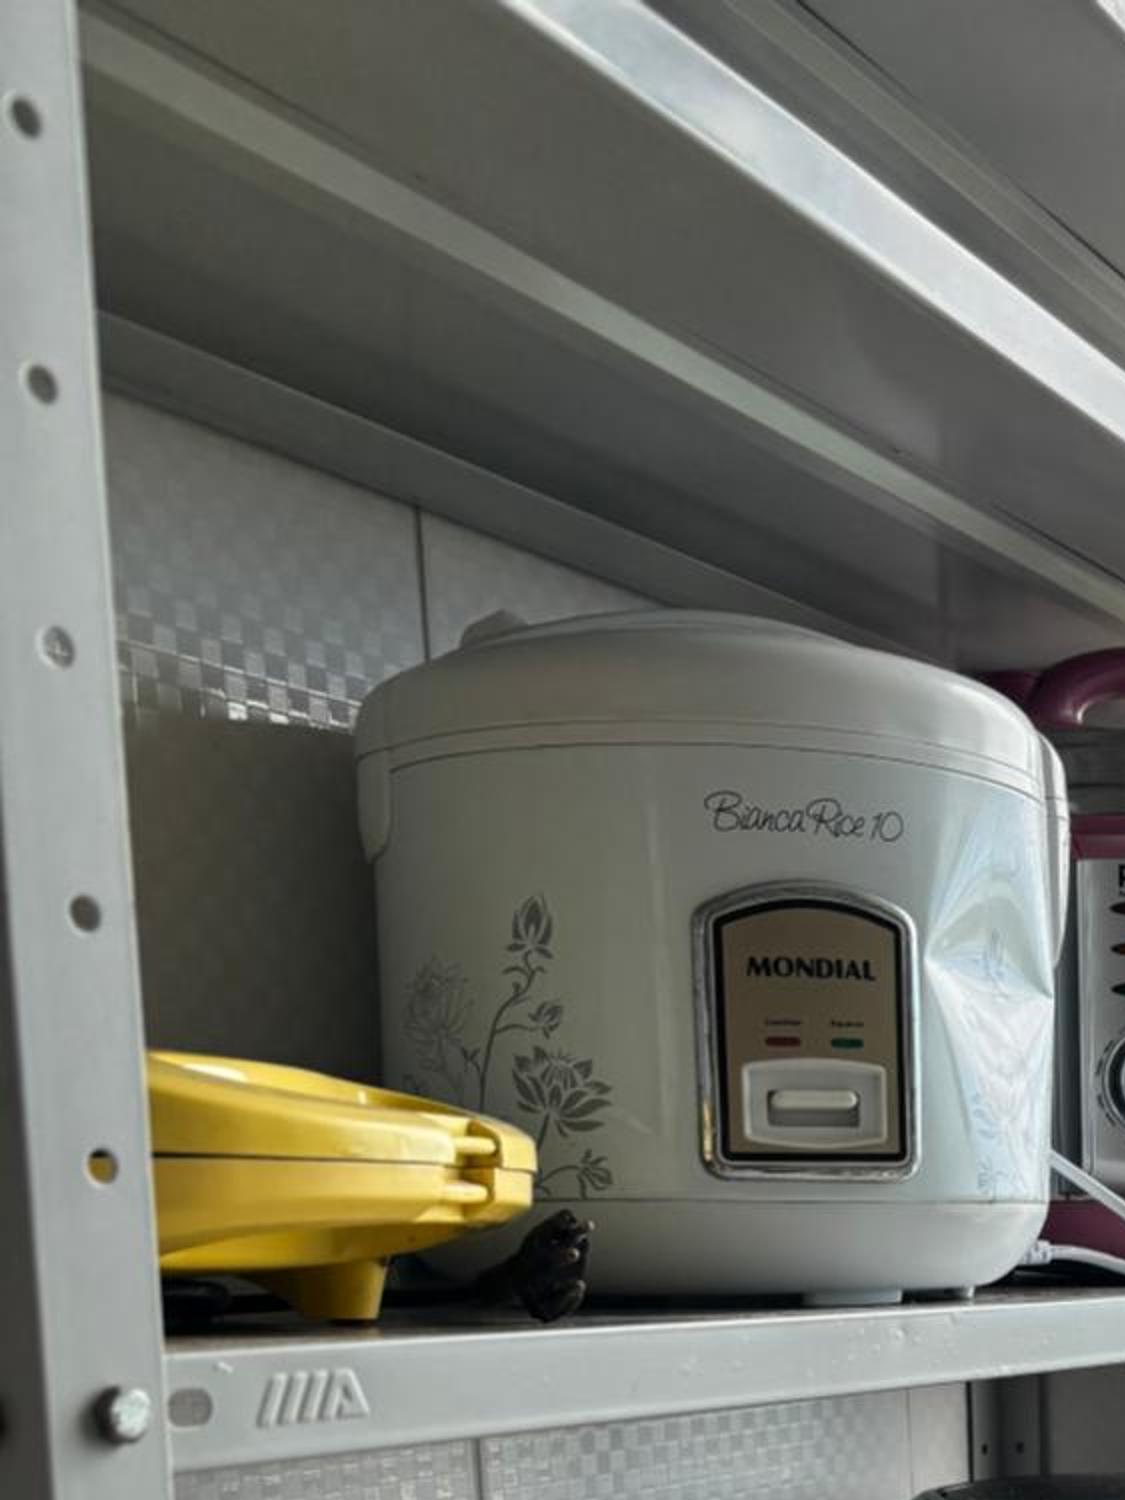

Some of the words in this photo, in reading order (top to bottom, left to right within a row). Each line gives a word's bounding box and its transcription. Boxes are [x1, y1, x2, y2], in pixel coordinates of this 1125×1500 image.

[703, 789, 806, 833] Bianca
[805, 797, 866, 838] Rice
[870, 810, 905, 843] 10
[746, 956, 877, 981] MONDIAL
